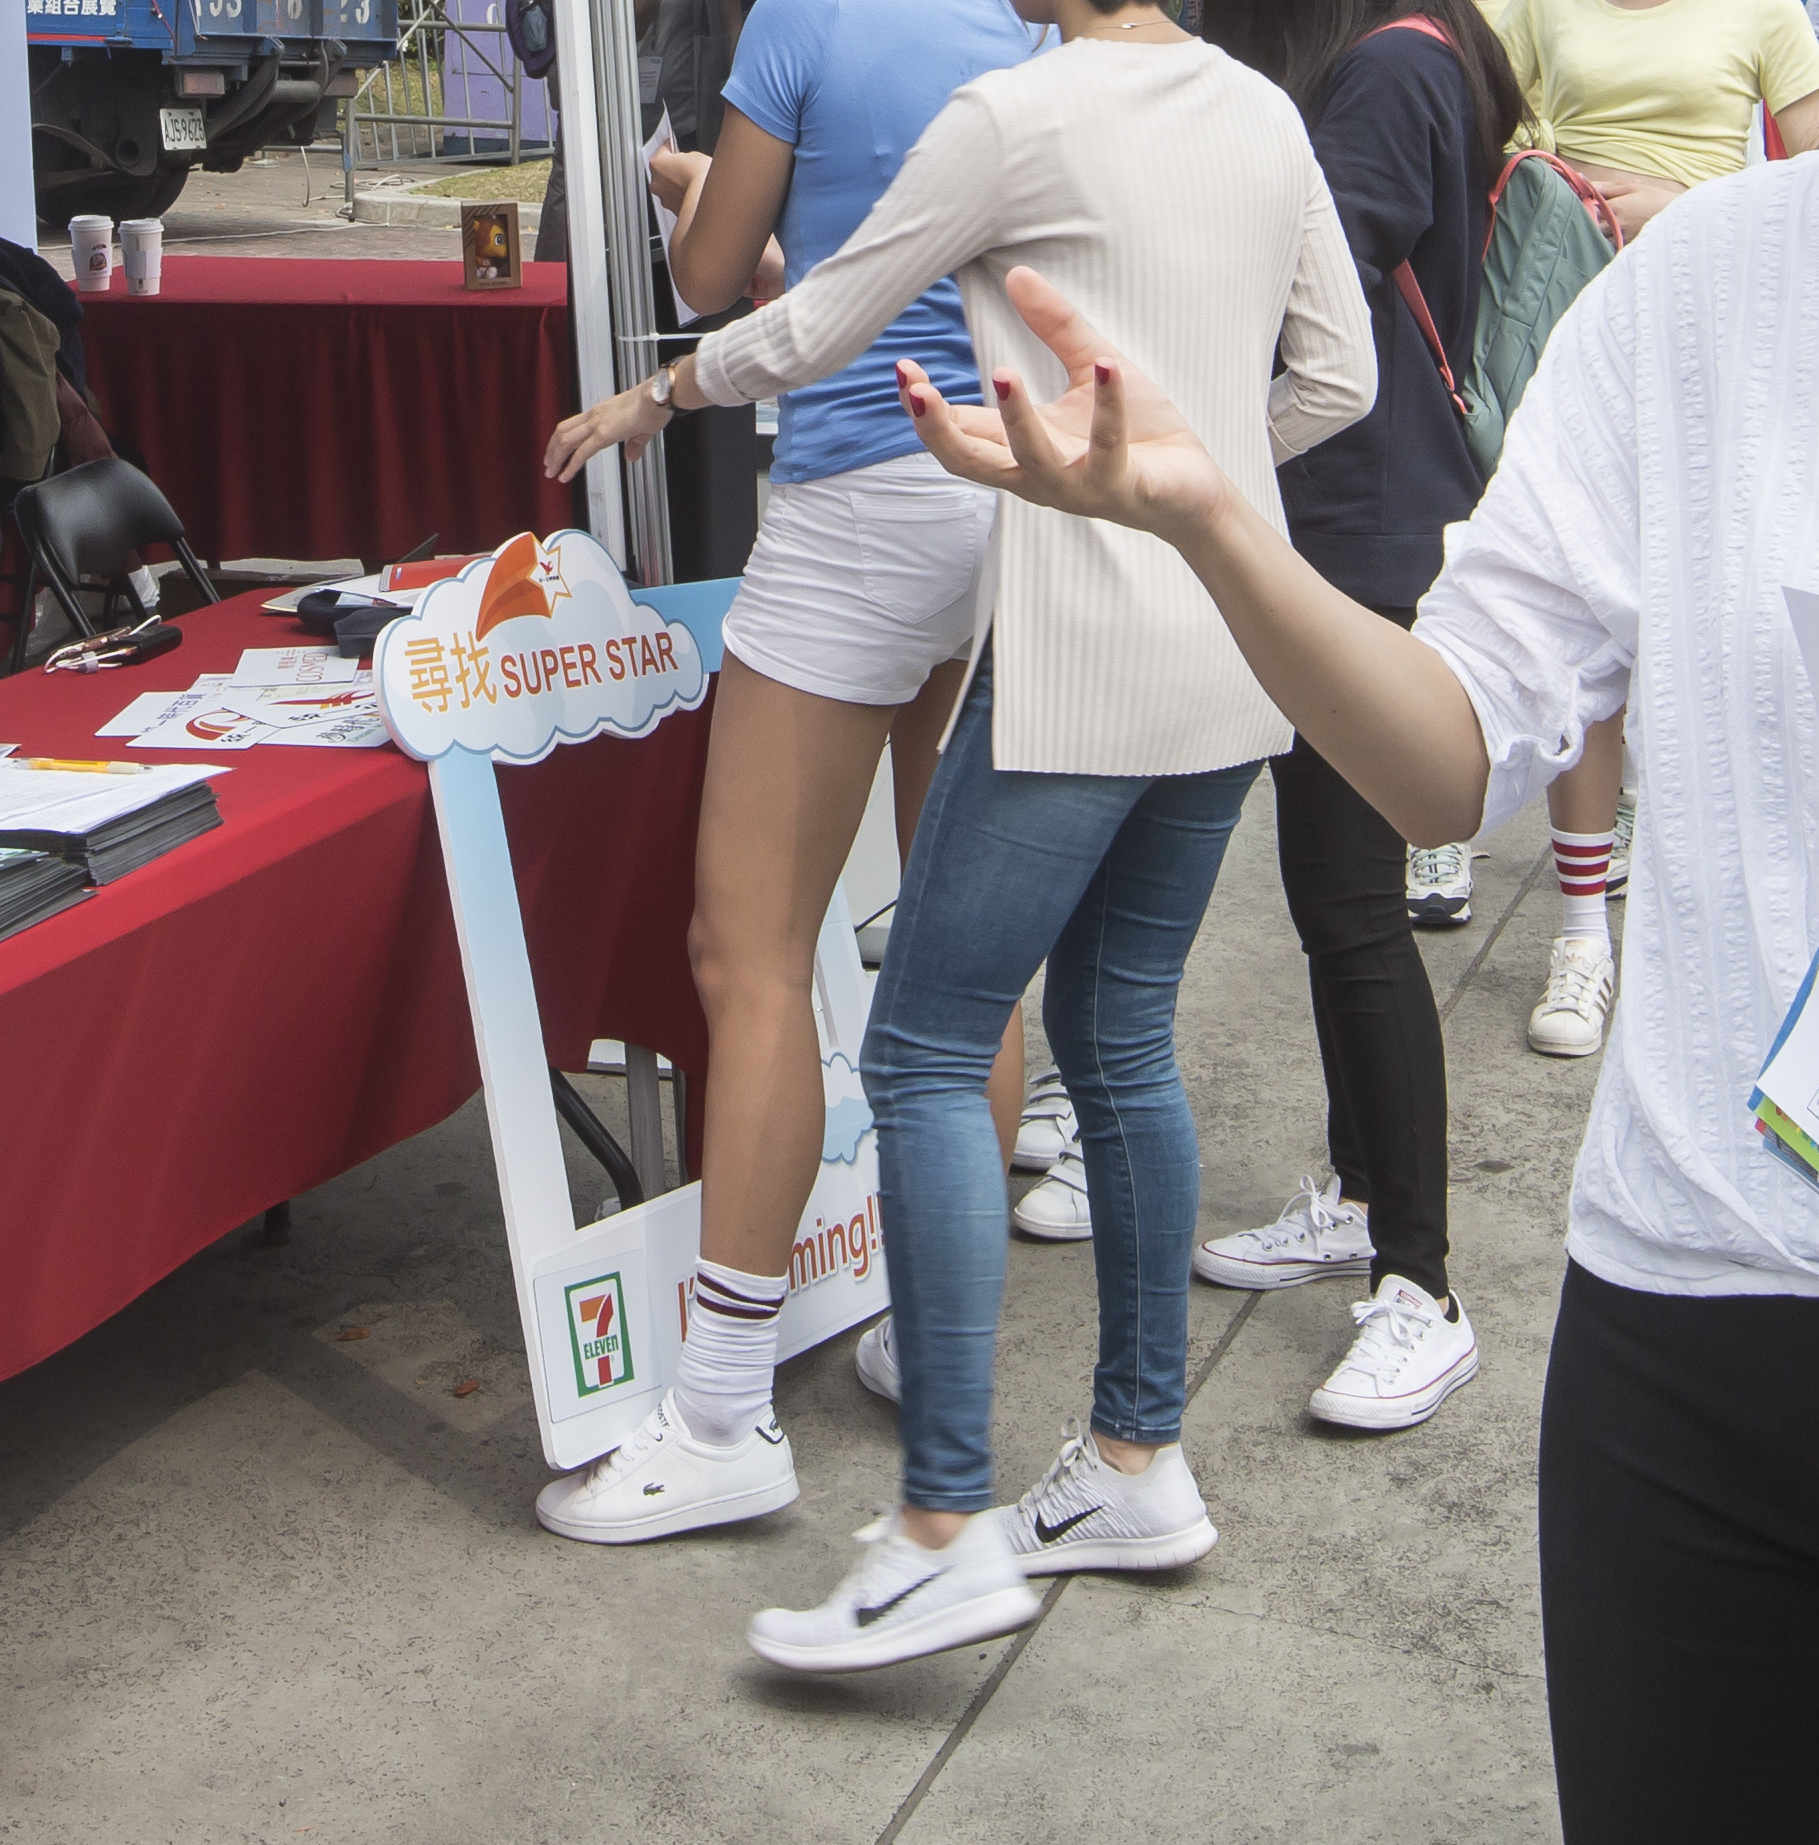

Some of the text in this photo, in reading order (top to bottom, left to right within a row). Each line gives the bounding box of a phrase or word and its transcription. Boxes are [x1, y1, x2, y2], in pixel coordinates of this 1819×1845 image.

[403, 630, 498, 714] 尋找
[499, 642, 603, 700] SUPER
[605, 630, 680, 682] STAR
